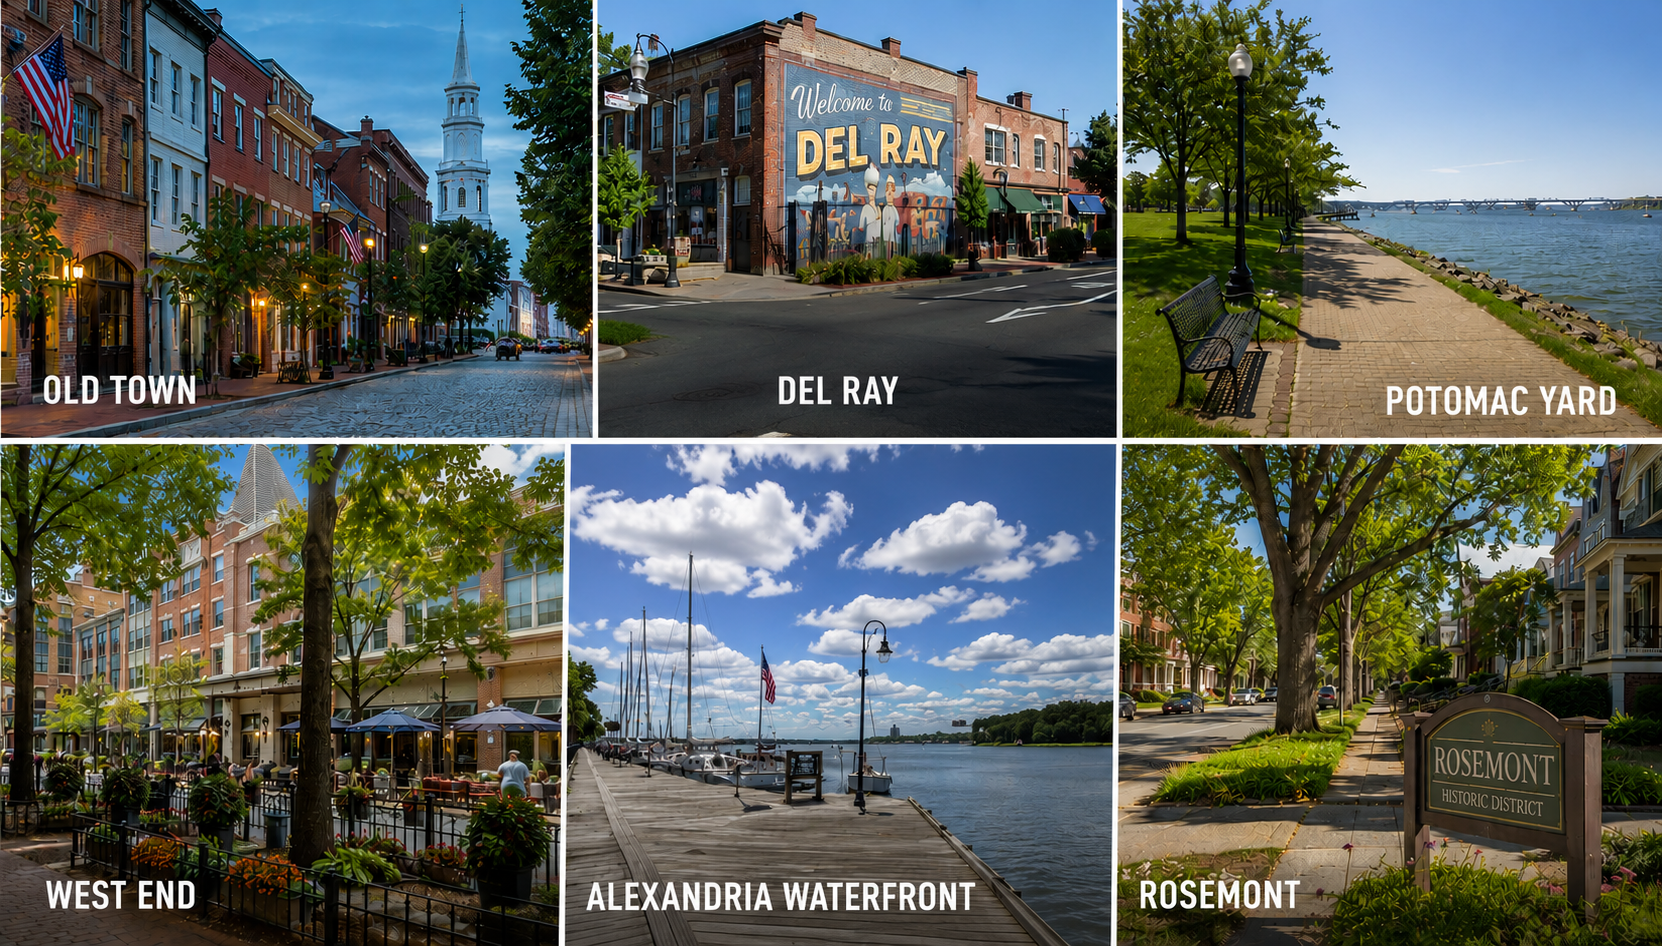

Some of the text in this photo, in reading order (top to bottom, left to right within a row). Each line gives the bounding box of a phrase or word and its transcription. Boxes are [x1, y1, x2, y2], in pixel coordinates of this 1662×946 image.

[790, 82, 894, 120] Welcome to
[796, 122, 947, 178] DEL RAY
[1434, 746, 1555, 786] ROSEMONT
[1442, 788, 1544, 817] HISTORIC DISTRICT
